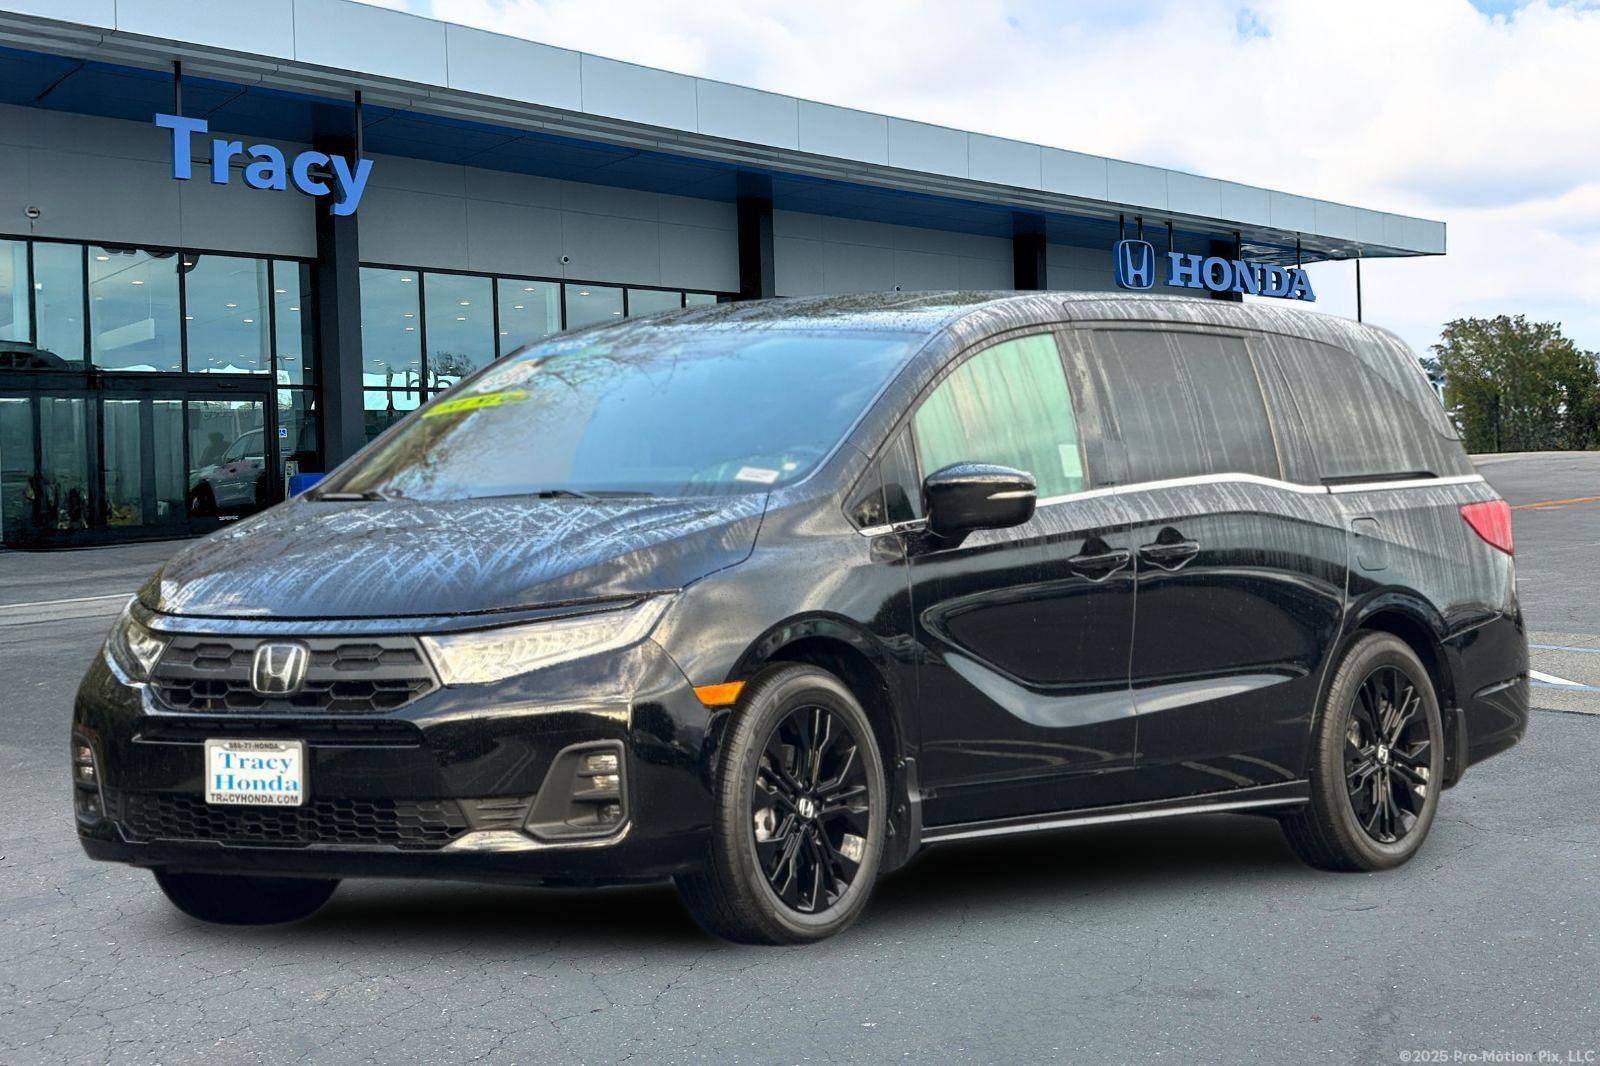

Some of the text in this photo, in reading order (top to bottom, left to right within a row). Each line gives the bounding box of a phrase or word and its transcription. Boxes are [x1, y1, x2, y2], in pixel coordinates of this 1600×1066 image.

[155, 113, 374, 216] Tracy
[1167, 251, 1316, 302] HONDA
[218, 752, 293, 774] Tracy
[215, 774, 299, 791] Honda
[211, 793, 299, 804] TRACYHONDA.COM
